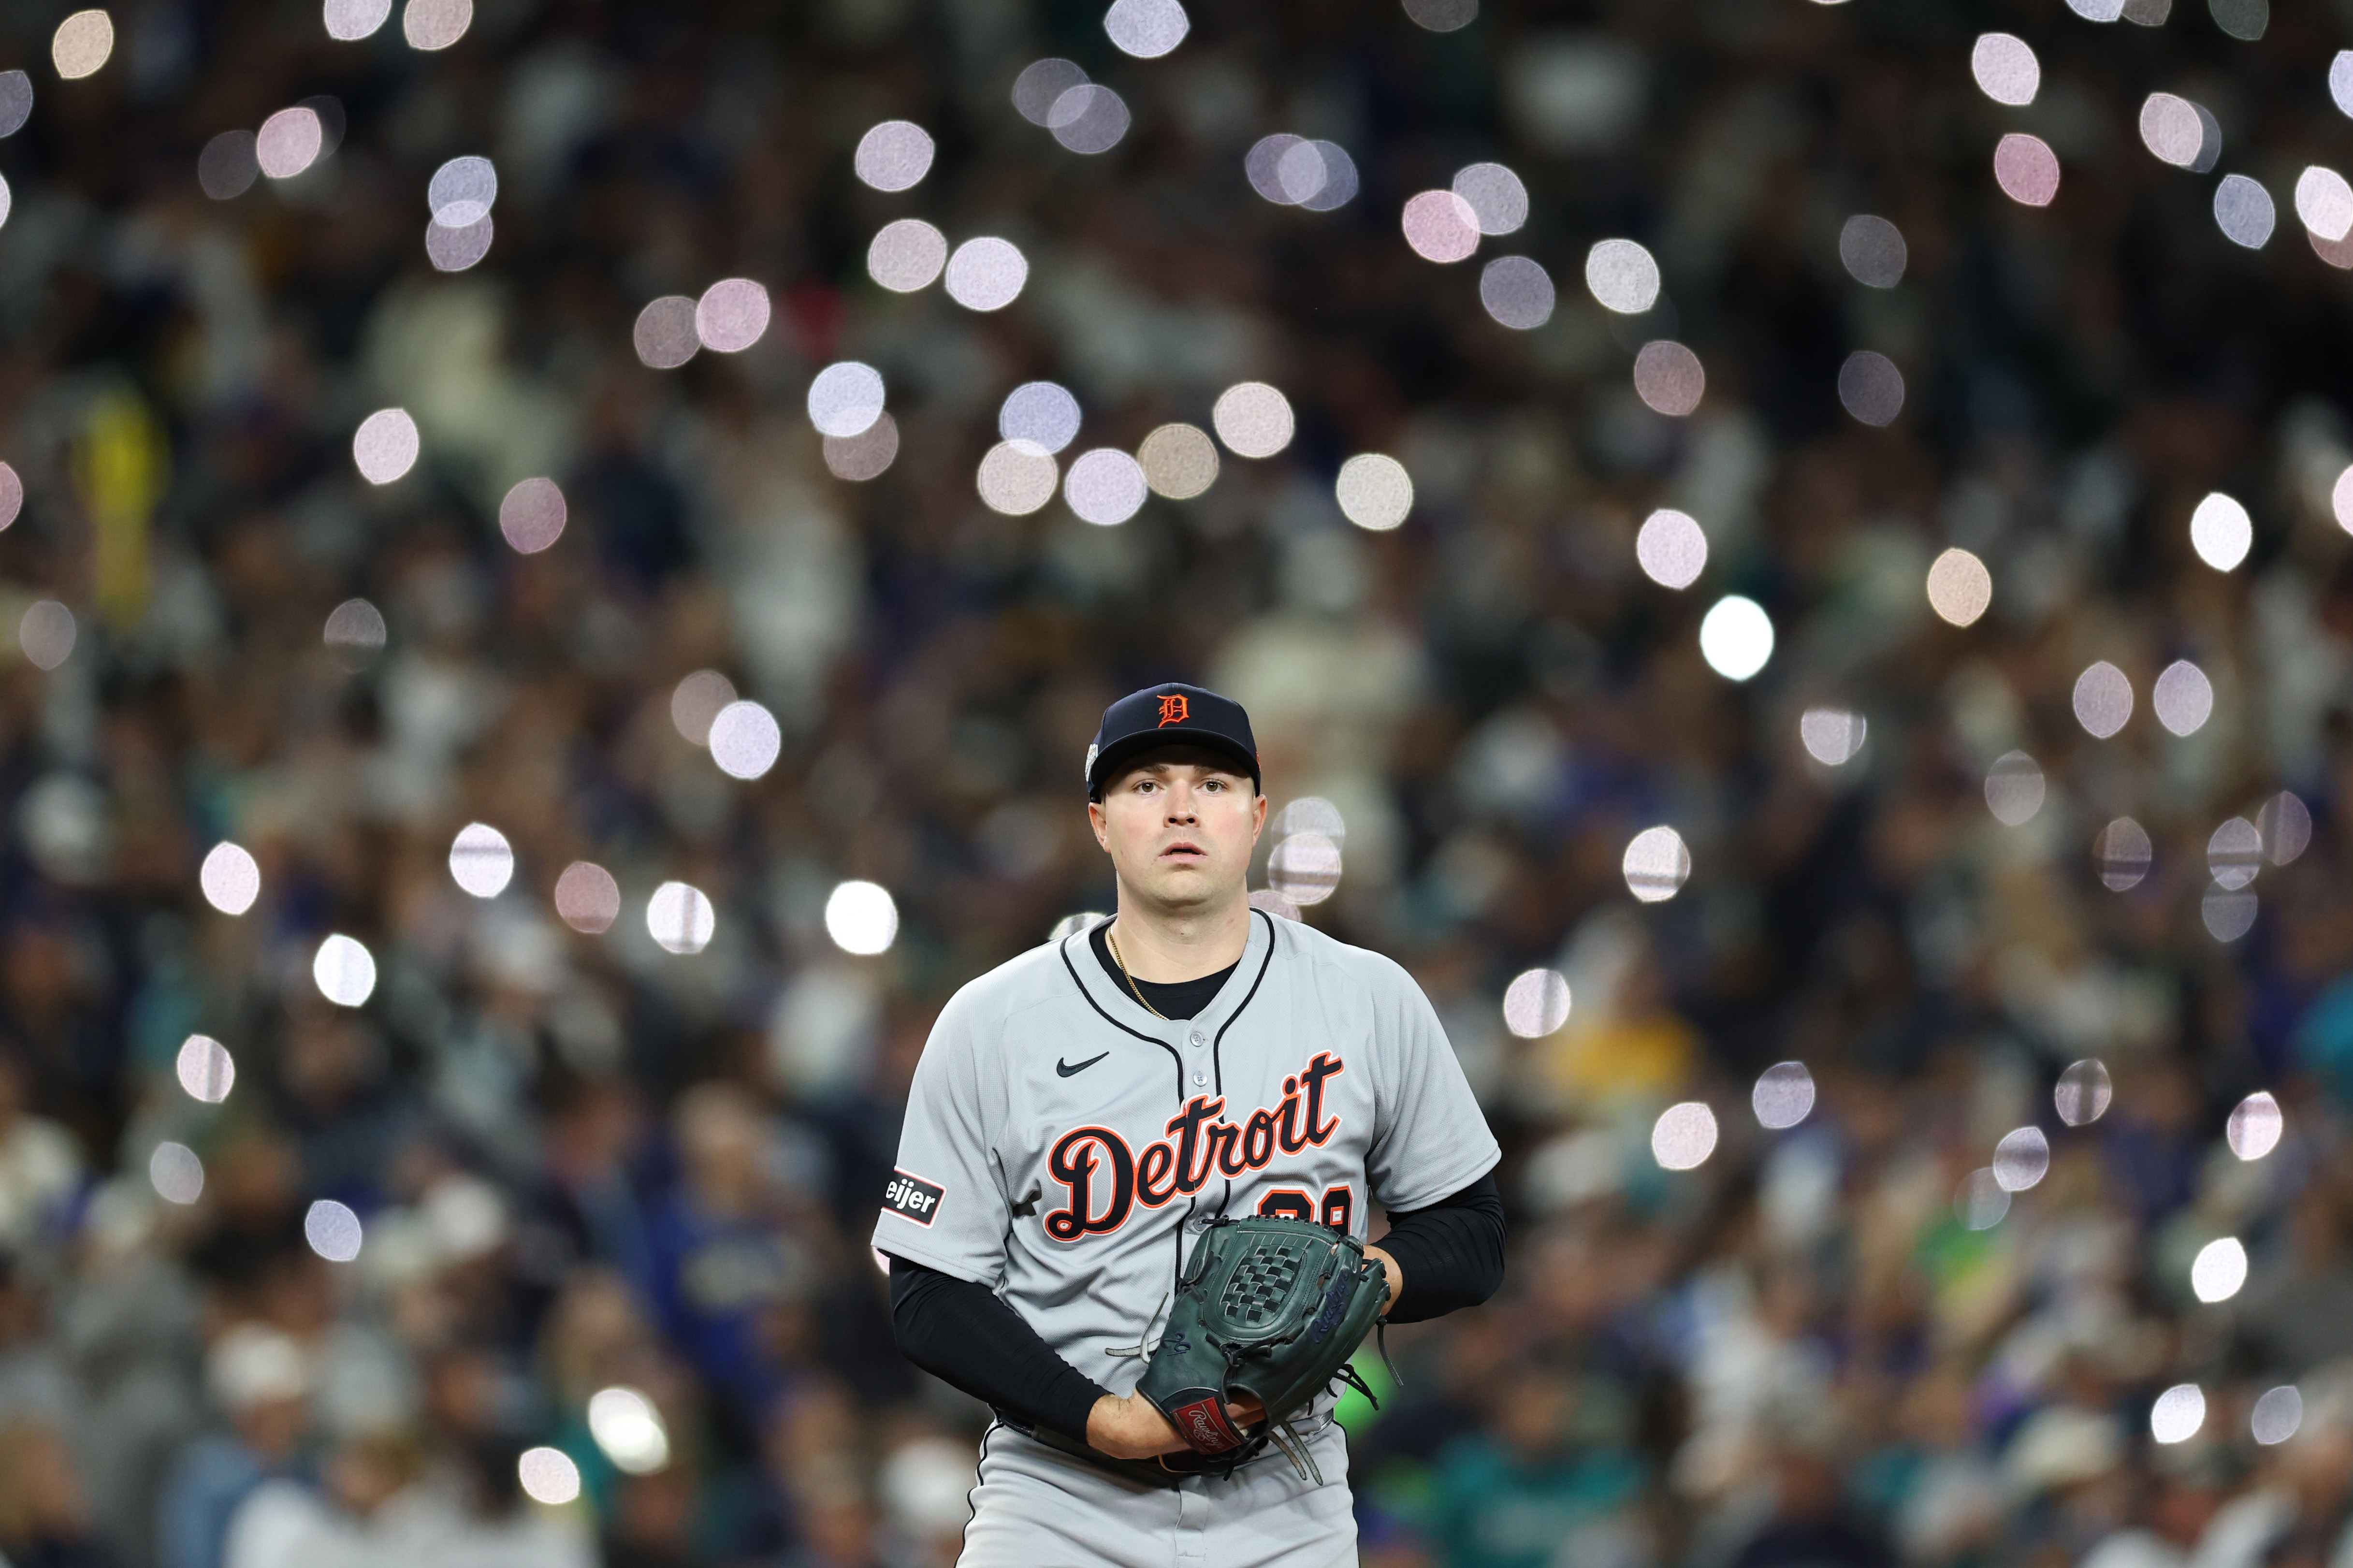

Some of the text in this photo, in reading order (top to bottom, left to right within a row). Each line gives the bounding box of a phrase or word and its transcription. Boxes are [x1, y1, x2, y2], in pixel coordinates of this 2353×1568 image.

[1157, 694, 1190, 728] D
[1043, 1049, 1345, 1243] Detroit
[1161, 1331, 1192, 1356] 29
